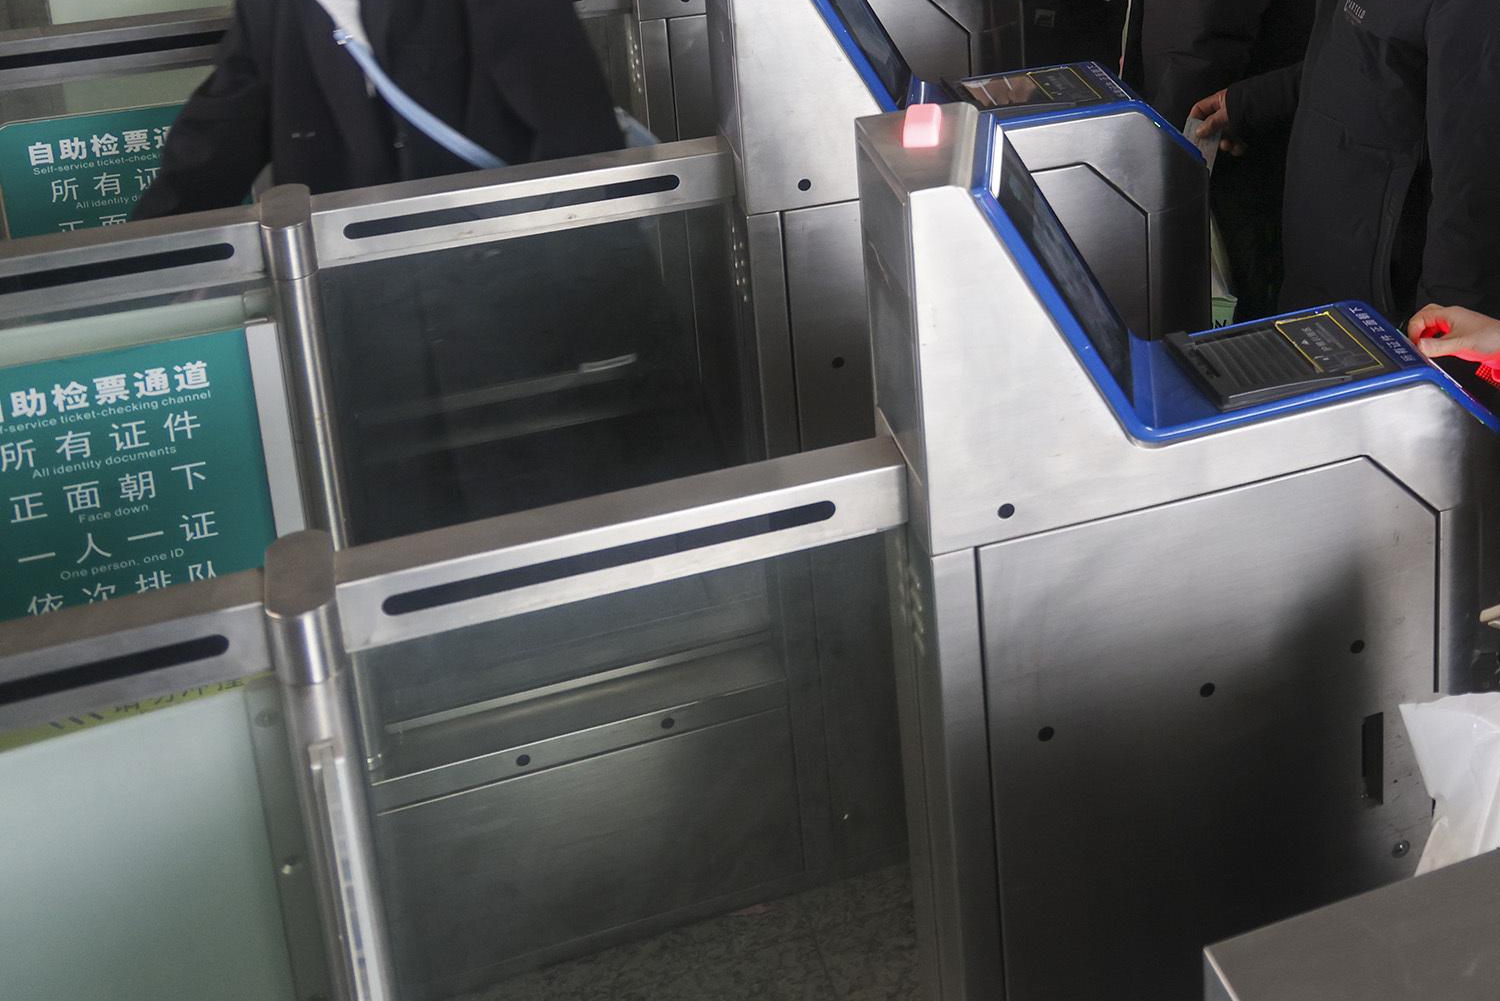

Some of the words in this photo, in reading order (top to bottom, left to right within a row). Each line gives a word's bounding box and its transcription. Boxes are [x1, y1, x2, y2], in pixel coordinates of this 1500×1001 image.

[33, 162, 94, 176] Self-service
[76, 201, 90, 209] All
[92, 197, 129, 208] identity
[0, 360, 210, 423] 助检票通道
[60, 399, 159, 424] ticket-checking
[161, 390, 212, 407] channel
[0, 410, 202, 473] 所有证件
[32, 466, 50, 479] All
[53, 459, 102, 477] identity
[105, 445, 177, 467] documents
[9, 461, 207, 524] 正面朝下
[78, 511, 112, 523] Face
[114, 503, 149, 517] down
[18, 510, 219, 565] 一人一证
[60, 569, 88, 581] One
[143, 553, 167, 565] one
[170, 548, 184, 559] ID
